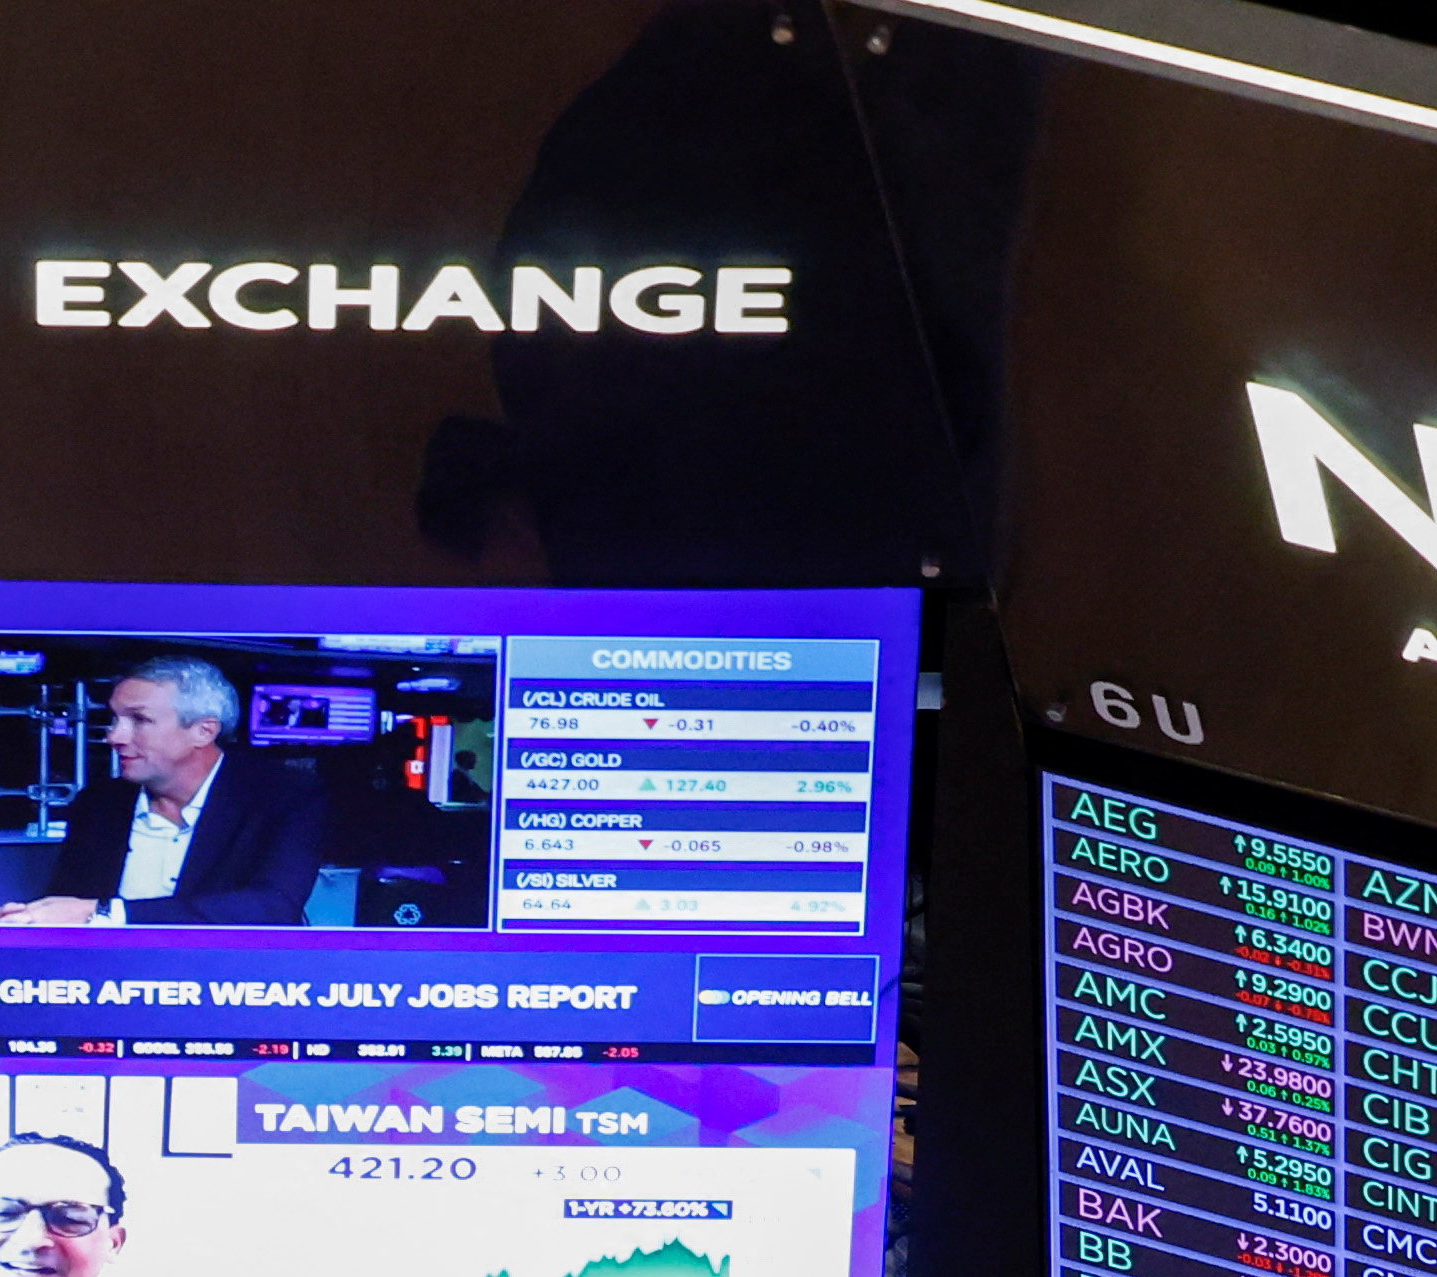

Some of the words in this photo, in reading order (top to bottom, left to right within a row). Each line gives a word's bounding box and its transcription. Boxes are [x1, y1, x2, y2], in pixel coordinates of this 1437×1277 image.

[35, 259, 792, 335] EXCHANGE
[592, 649, 792, 672] COMMODITIES
[569, 693, 632, 707] CRUDE
[635, 693, 665, 707] OIL
[1089, 678, 1204, 747] 6U
[528, 718, 579, 730] 76.98
[571, 753, 622, 767] GOLD
[526, 778, 599, 791] 4427.00
[665, 779, 727, 792] 127.40
[1071, 792, 1157, 840] AEG
[1251, 838, 1331, 875] 9.5550
[1071, 837, 1169, 883] AERO
[1237, 880, 1331, 920] 15.9100
[97, 981, 201, 1006] AFTER
[208, 982, 310, 1006] WEAK
[317, 983, 402, 1008] JULY
[407, 984, 498, 1008] JOBS
[507, 984, 638, 1009] REPORT
[731, 989, 820, 1005] OPENING
[826, 990, 872, 1005] BELL
[254, 1103, 443, 1134] TAIWAN
[455, 1106, 564, 1134] SEMI
[576, 1111, 648, 1135] TSM
[328, 1156, 476, 1181] 421.20
